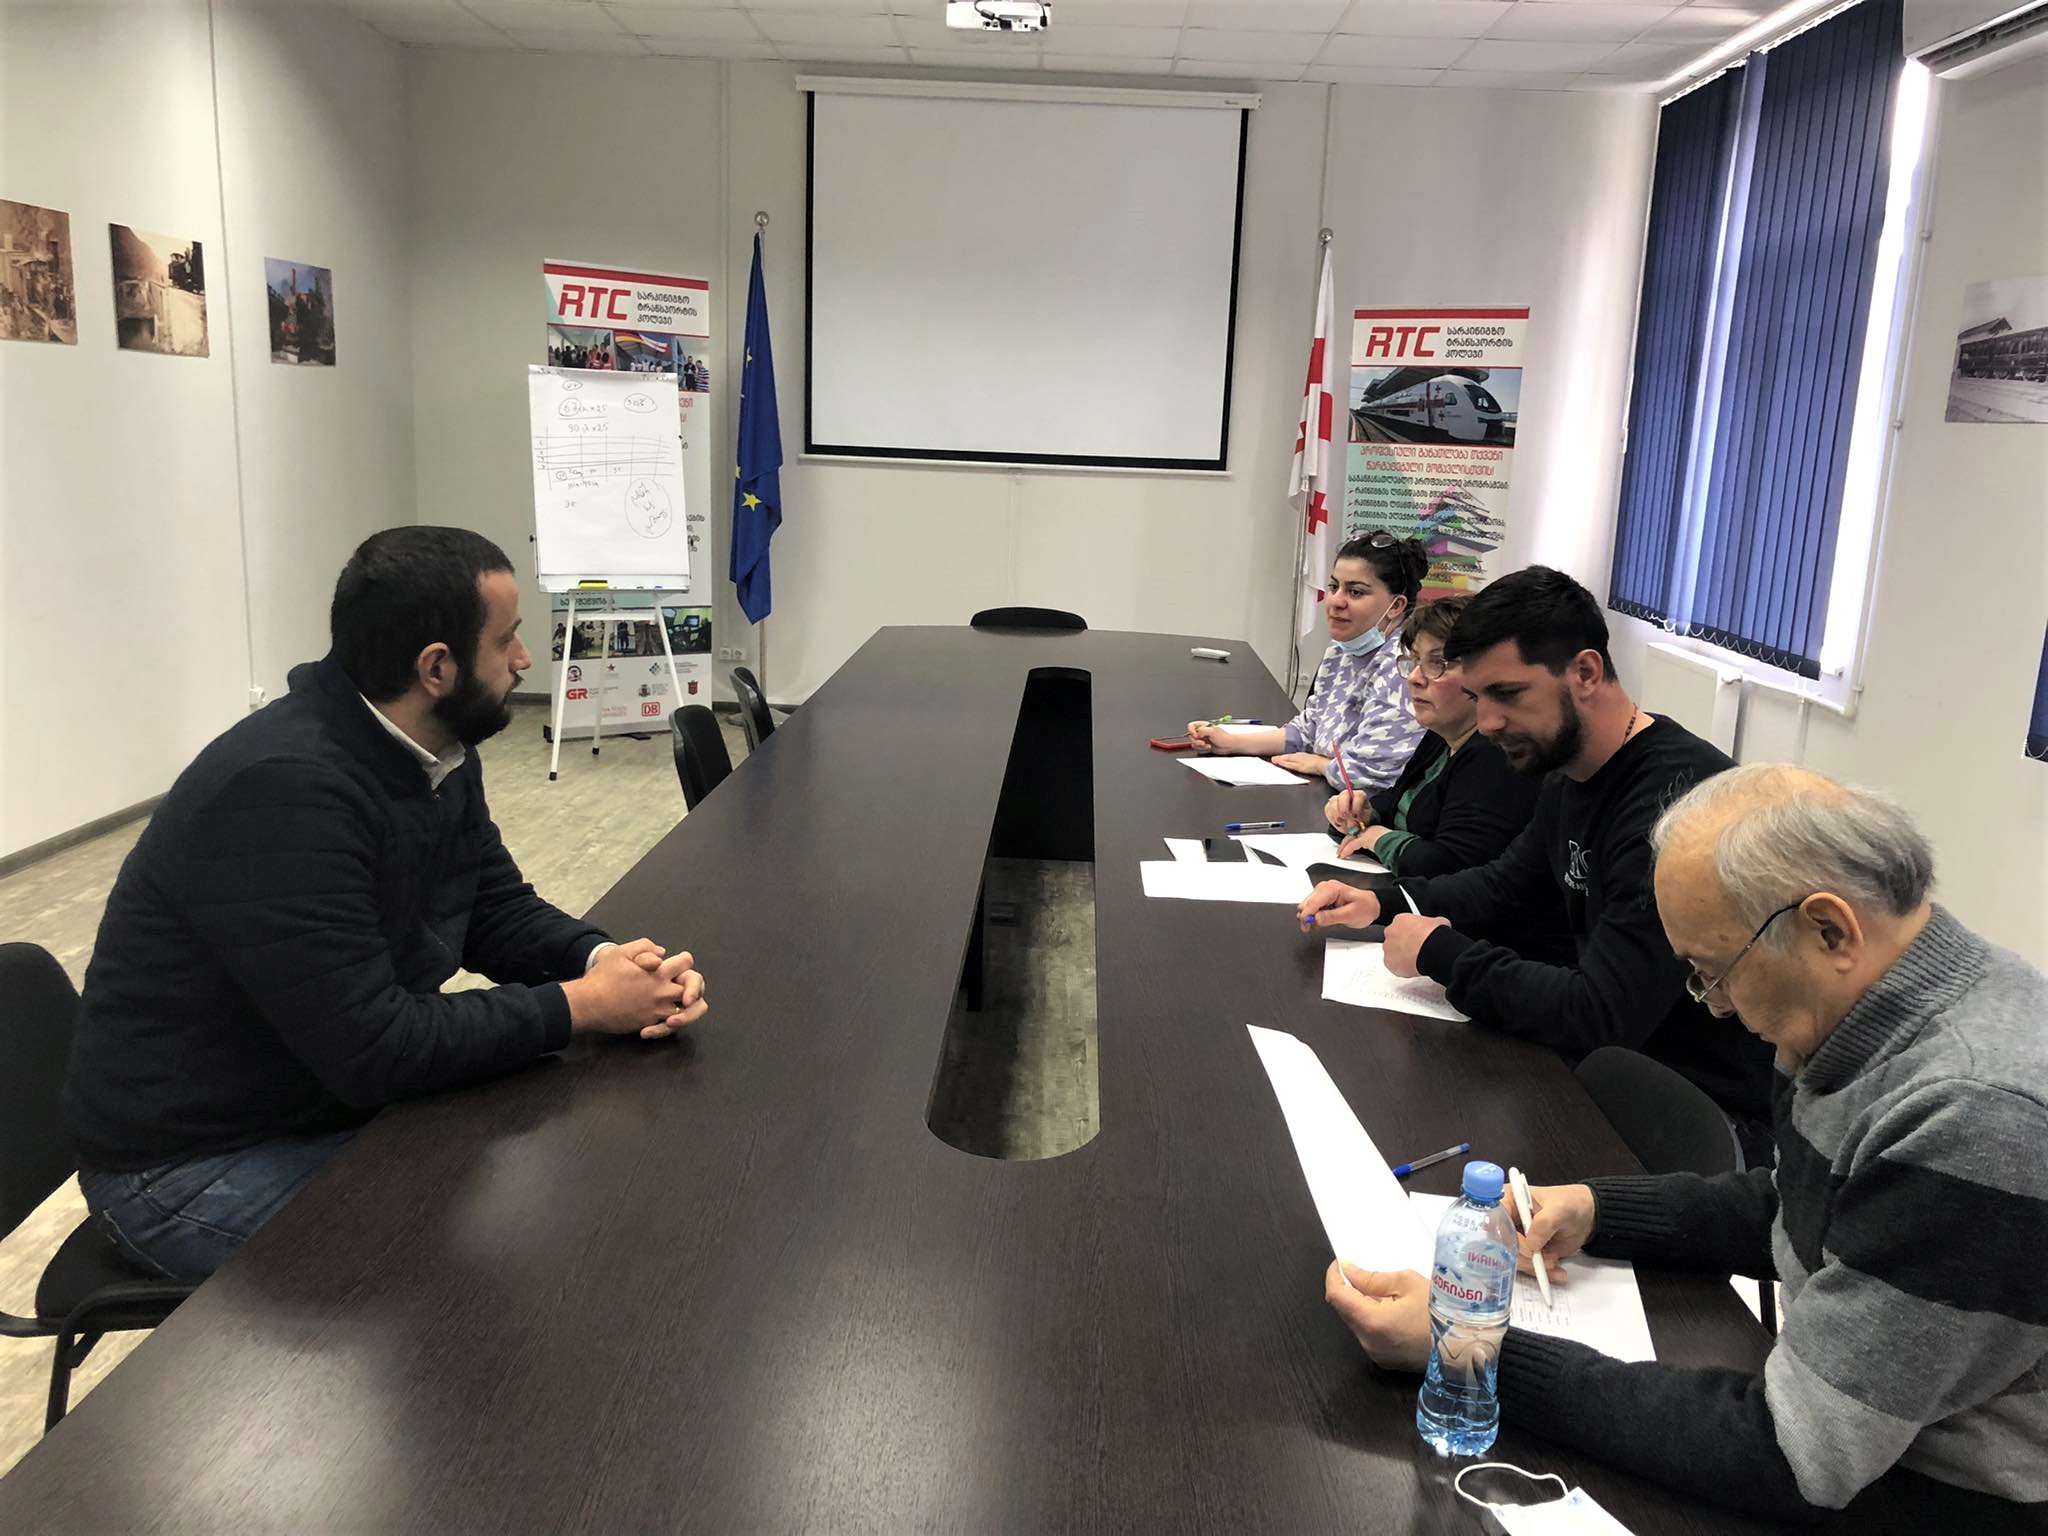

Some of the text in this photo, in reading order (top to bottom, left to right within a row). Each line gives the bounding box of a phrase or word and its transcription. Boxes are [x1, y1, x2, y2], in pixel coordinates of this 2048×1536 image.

[558, 284, 632, 321] RTC
[637, 290, 690, 305] სარკინიგზო
[637, 303, 698, 317] ტრანსპორტის
[1447, 326, 1506, 336] სარკინიგზო
[1365, 326, 1441, 358] RTC
[1446, 338, 1513, 348] ტრანსპორტის
[1445, 349, 1483, 359] კოლეჯი
[566, 687, 589, 700] GR
